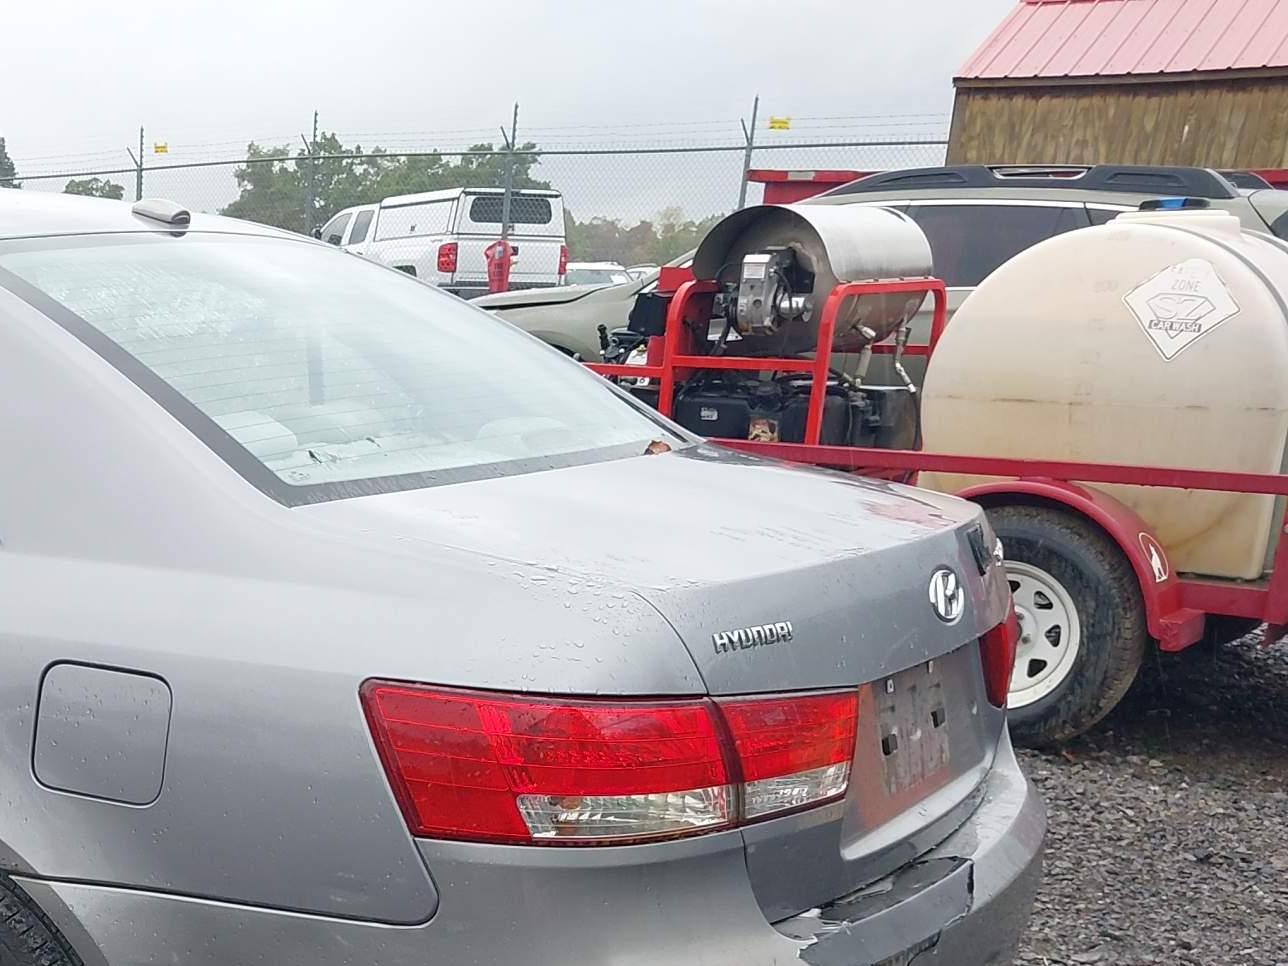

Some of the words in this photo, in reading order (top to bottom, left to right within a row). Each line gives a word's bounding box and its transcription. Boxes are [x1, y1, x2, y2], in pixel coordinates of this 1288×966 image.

[1171, 279, 1201, 293] ZONE
[1151, 320, 1171, 331] CAR
[1172, 321, 1200, 333] WASH
[712, 620, 793, 654] HYUNDAI
